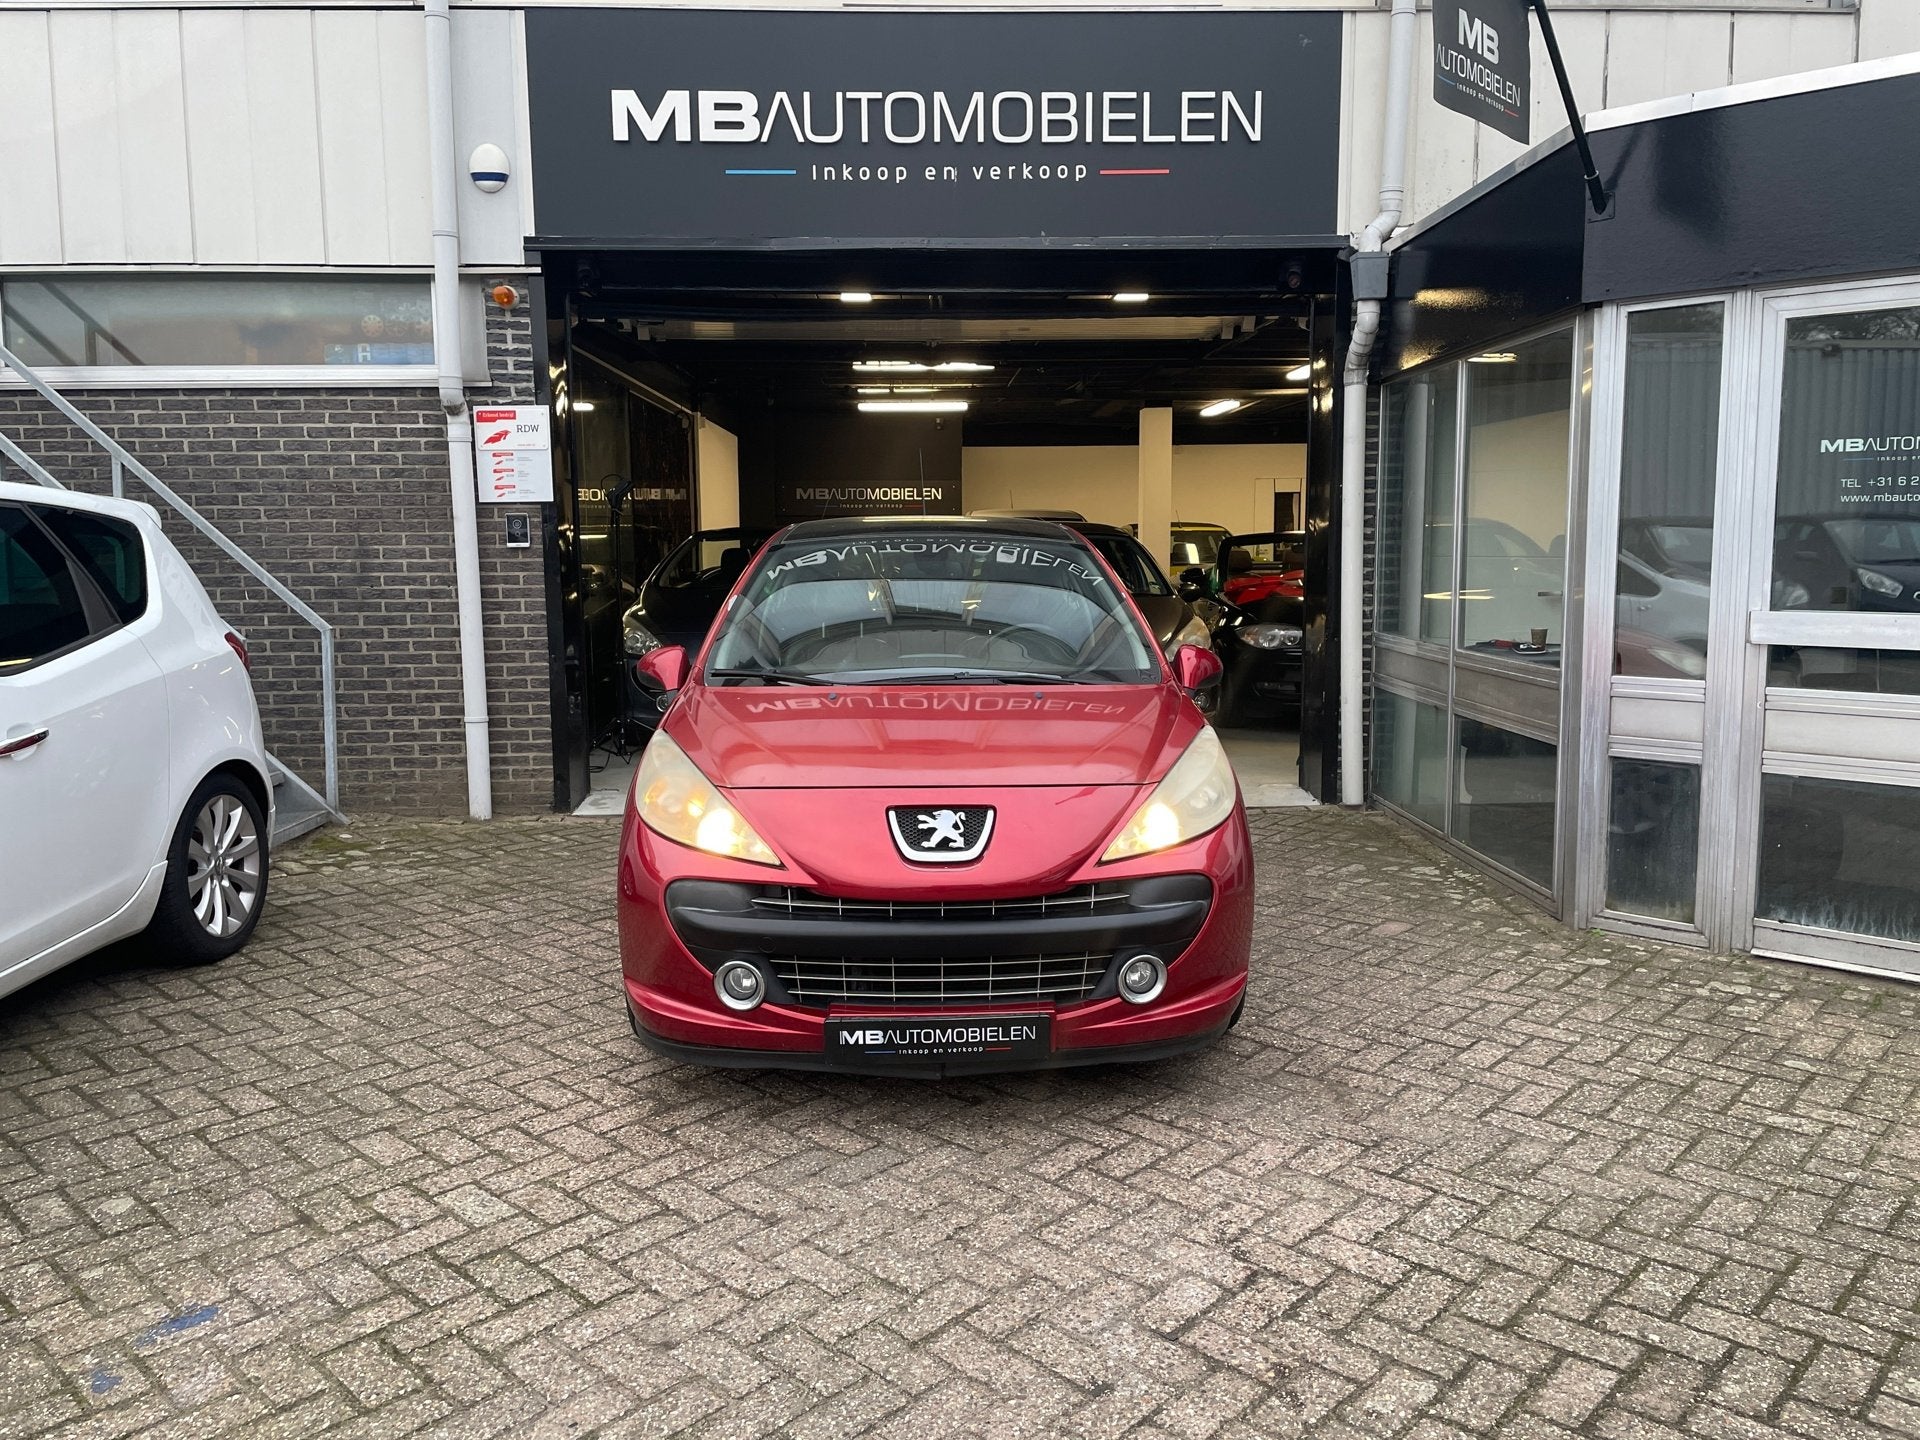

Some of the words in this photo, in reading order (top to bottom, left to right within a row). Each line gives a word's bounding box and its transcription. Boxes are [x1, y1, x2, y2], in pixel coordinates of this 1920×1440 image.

[1458, 8, 1500, 65] MB
[1436, 43, 1521, 107] AUTOMOBIELEN
[610, 89, 1264, 144] MBAUTOMOBIELEN
[924, 165, 956, 181] en
[972, 162, 1088, 182] verkoop
[516, 424, 540, 433] RDW
[1820, 436, 1920, 453] MBAUTO
[1841, 478, 1862, 488] TEL
[1868, 477, 1892, 487] +31
[1898, 476, 1907, 486] 6
[1911, 476, 1919, 486] 2
[795, 488, 942, 500] MBAUTOMOBIELEN
[1840, 493, 1920, 503] www.mbauto
